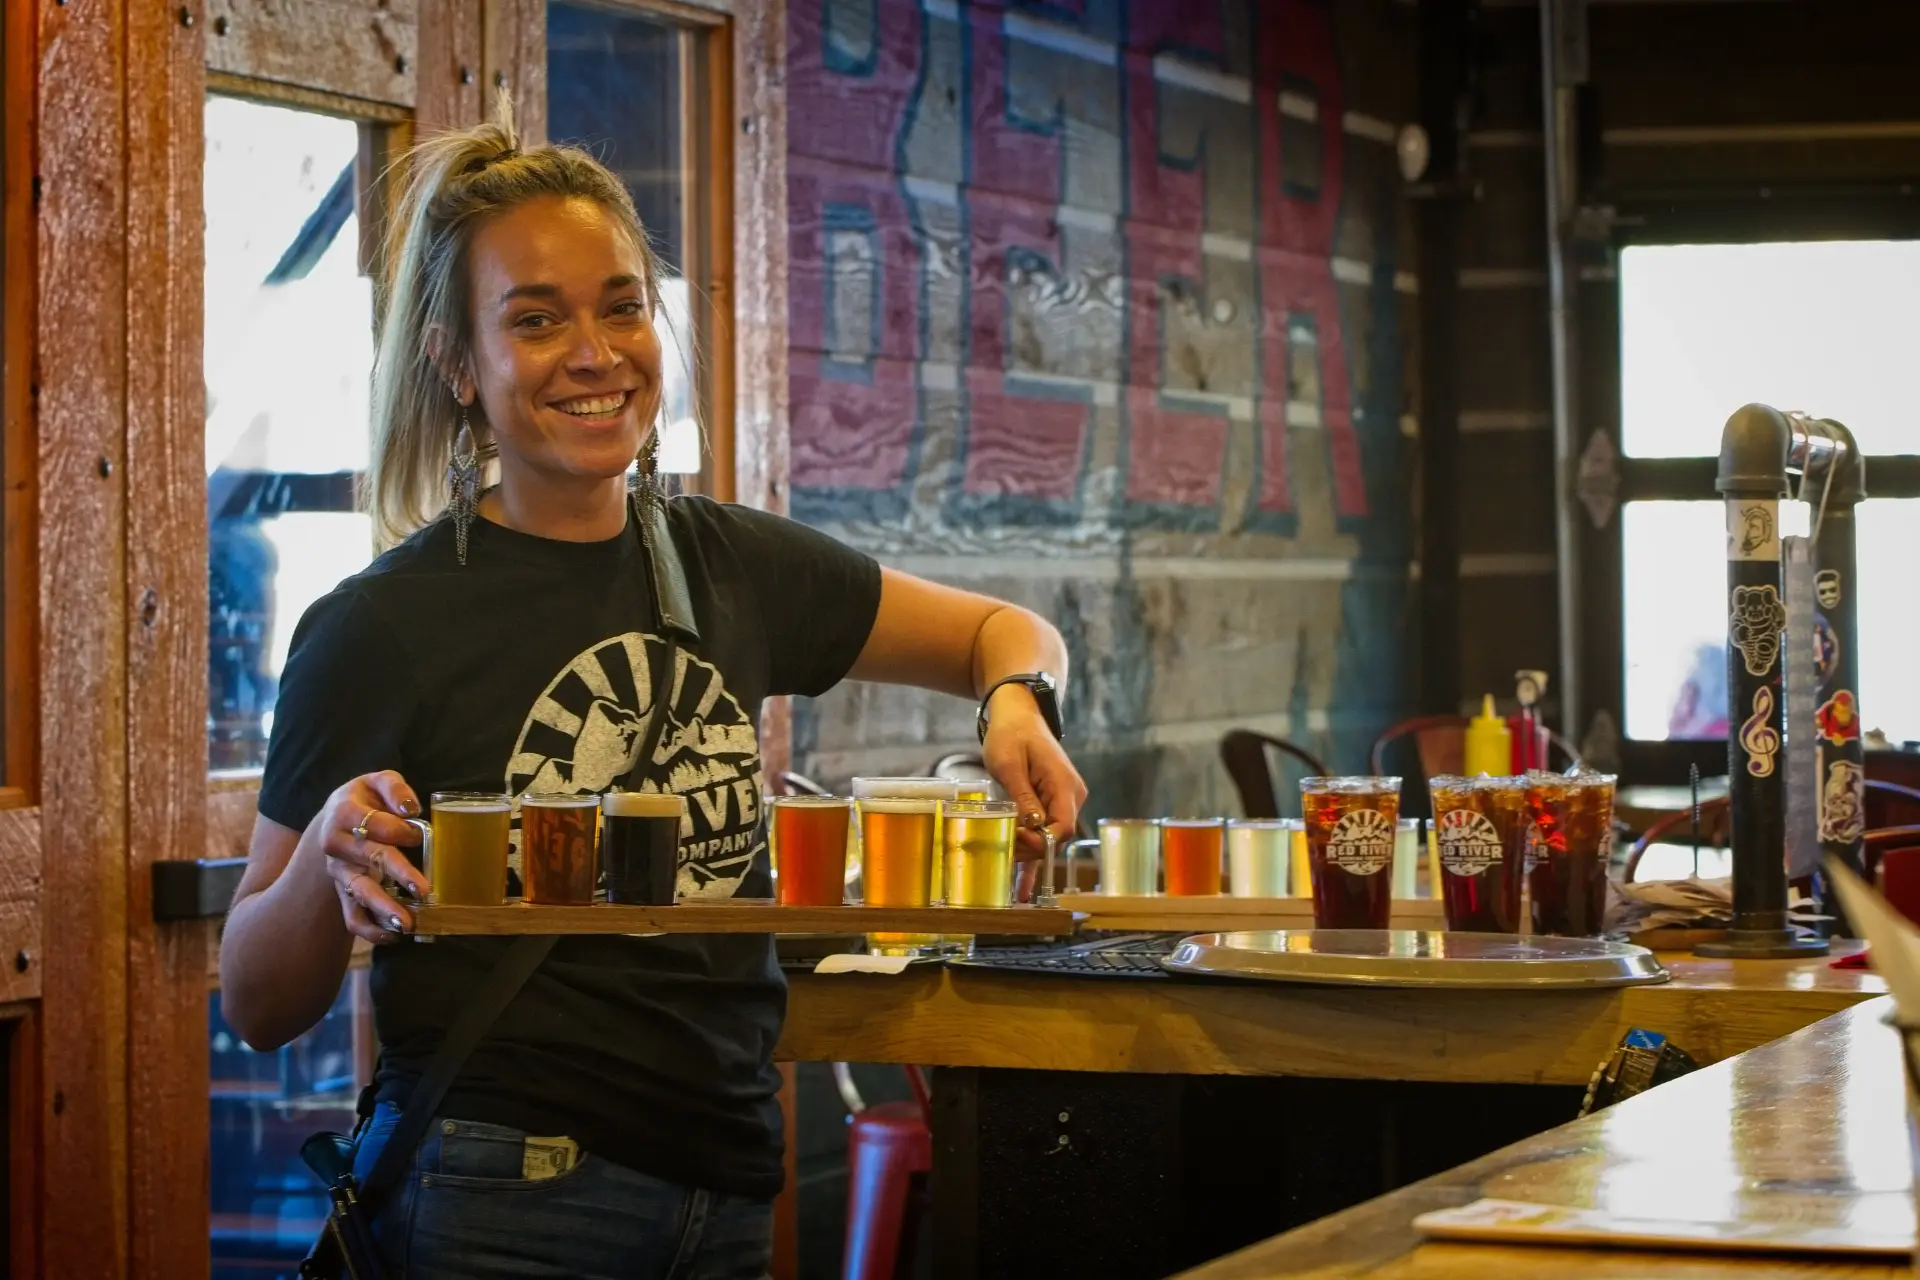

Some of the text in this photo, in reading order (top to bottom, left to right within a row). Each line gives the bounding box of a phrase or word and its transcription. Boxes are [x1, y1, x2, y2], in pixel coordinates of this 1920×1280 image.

[788, 0, 1368, 522] BEER
[679, 771, 763, 834] IVE
[677, 829, 754, 862] OMPANY
[1326, 844, 1356, 859] RED
[1459, 844, 1503, 859] RIVER
